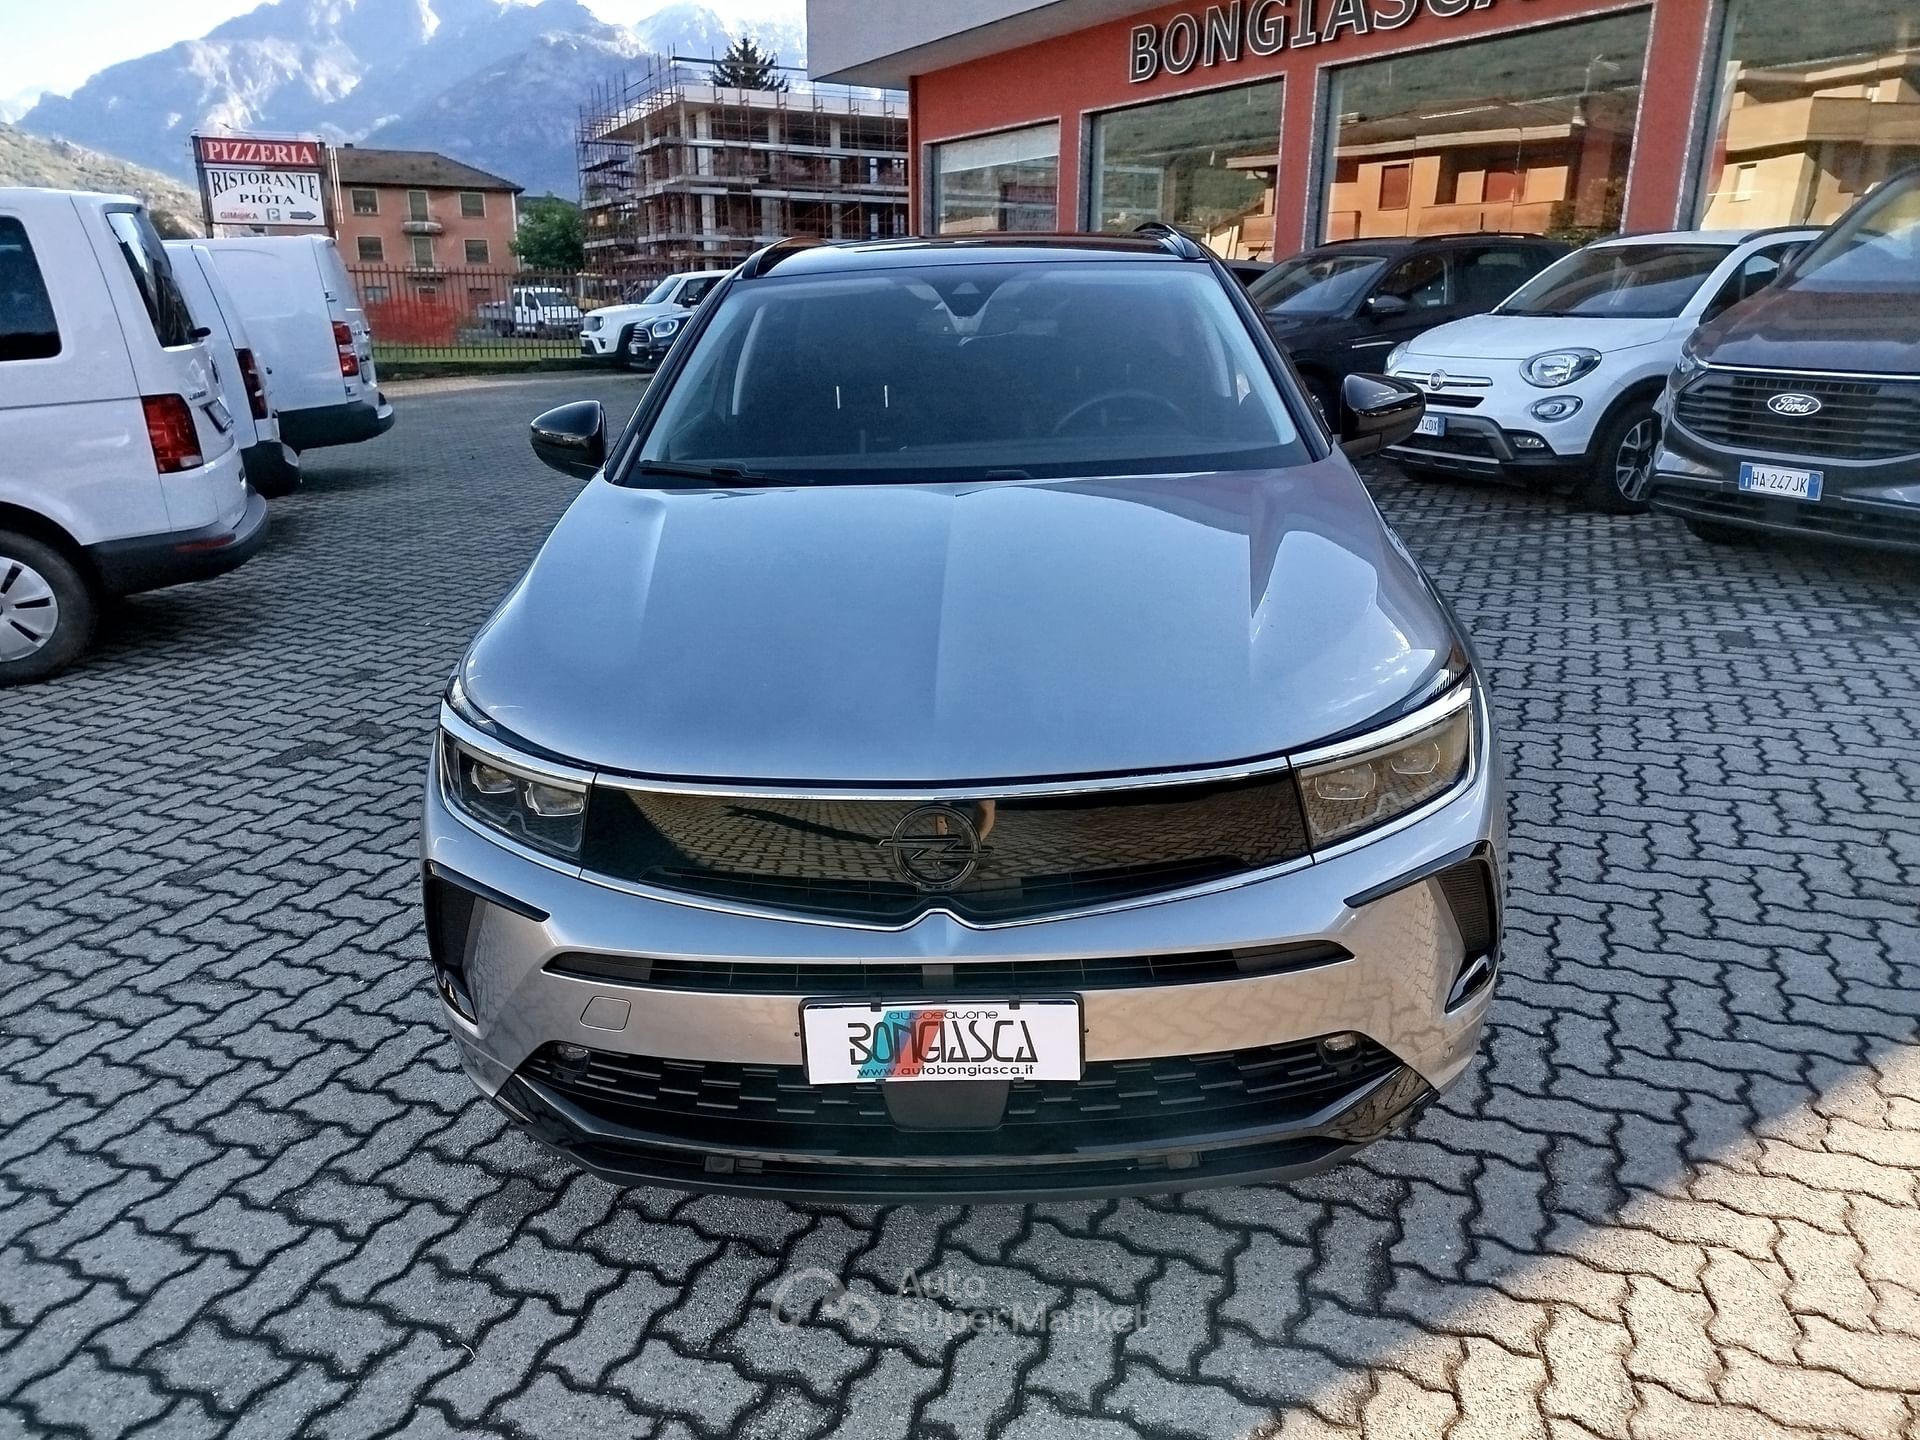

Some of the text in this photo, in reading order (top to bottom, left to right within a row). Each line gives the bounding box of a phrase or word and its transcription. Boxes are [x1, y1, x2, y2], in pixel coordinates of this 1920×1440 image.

[1128, 0, 1535, 84] BONGIA
[206, 141, 314, 165] PIZZERIA
[210, 171, 319, 202] RISTORANTE
[259, 186, 273, 194] LA
[239, 194, 295, 205] PIOTA
[1775, 396, 1812, 414] Ford
[889, 1010, 999, 1021] autosalone
[847, 1020, 1039, 1066] BONGIASCA
[857, 1064, 1034, 1078] www.autobongiasca.it
